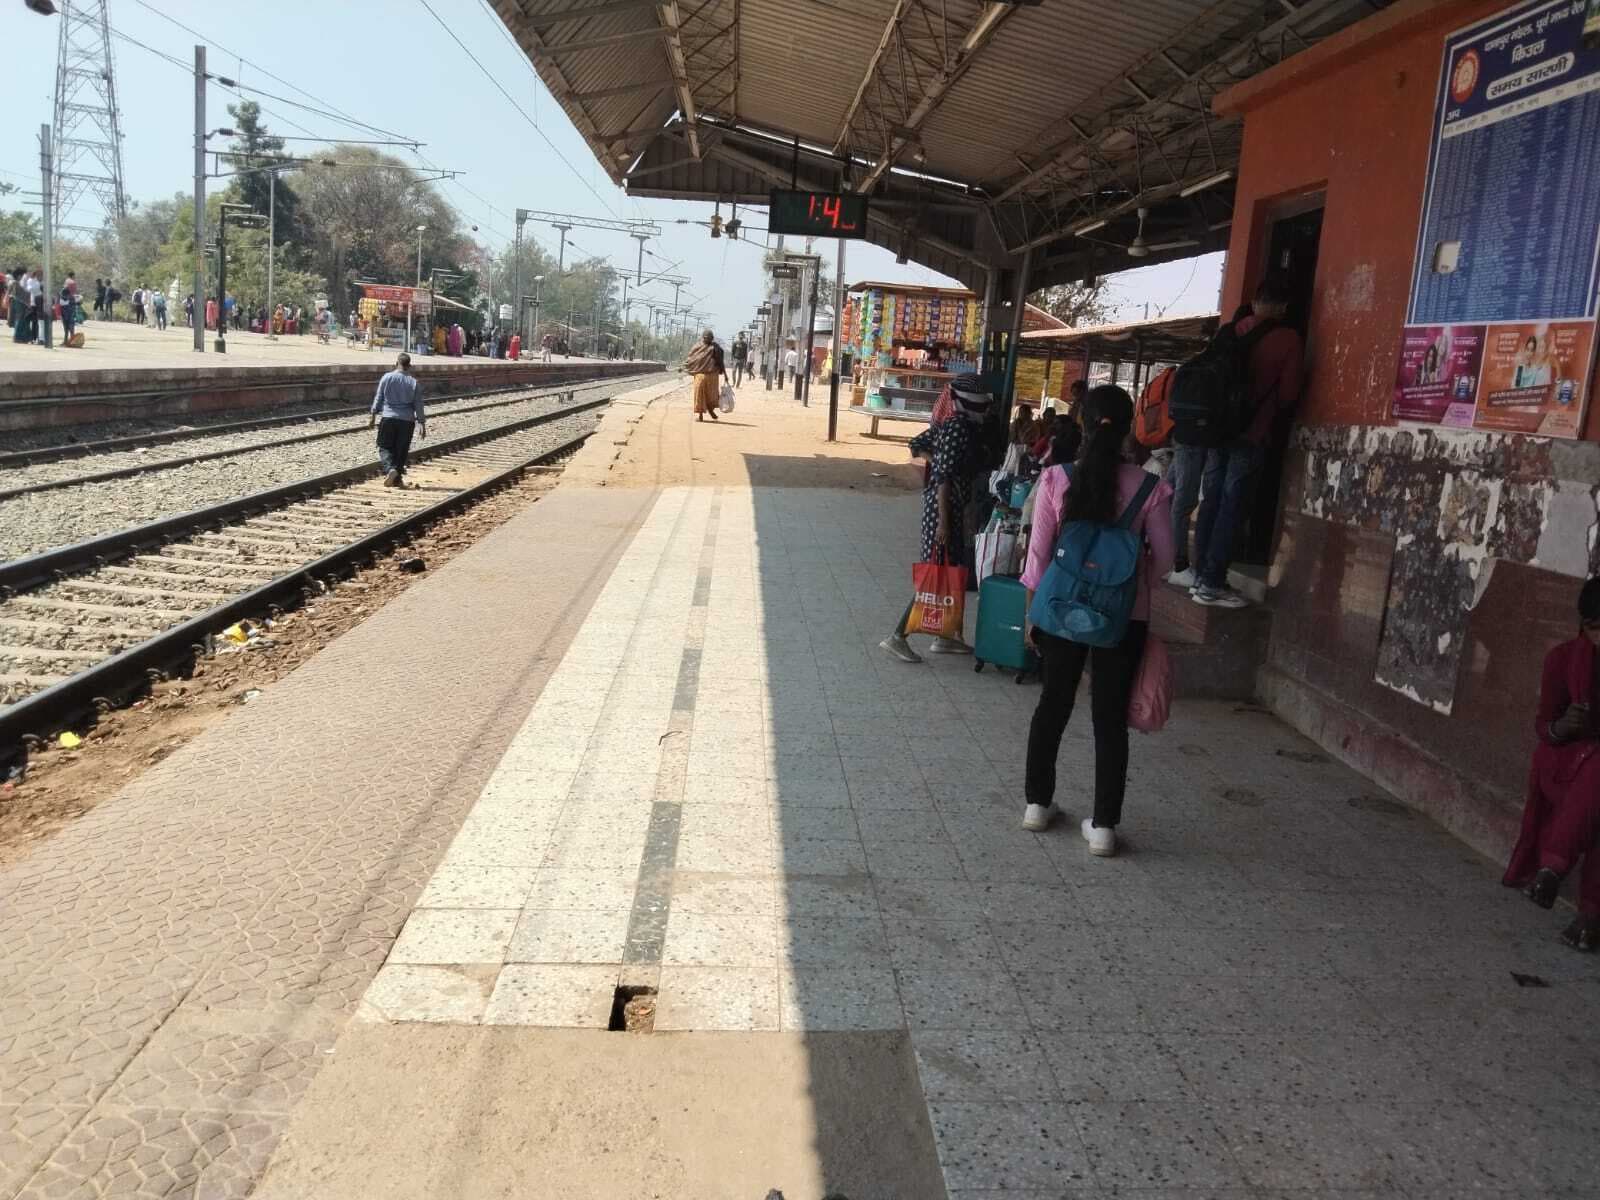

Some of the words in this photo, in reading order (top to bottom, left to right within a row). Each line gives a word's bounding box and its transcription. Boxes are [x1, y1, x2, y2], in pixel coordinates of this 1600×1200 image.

[1512, 40, 1547, 64] किउल
[1490, 76, 1522, 96] समय
[1526, 56, 1568, 83] सारणी
[915, 591, 954, 606] HELLO
